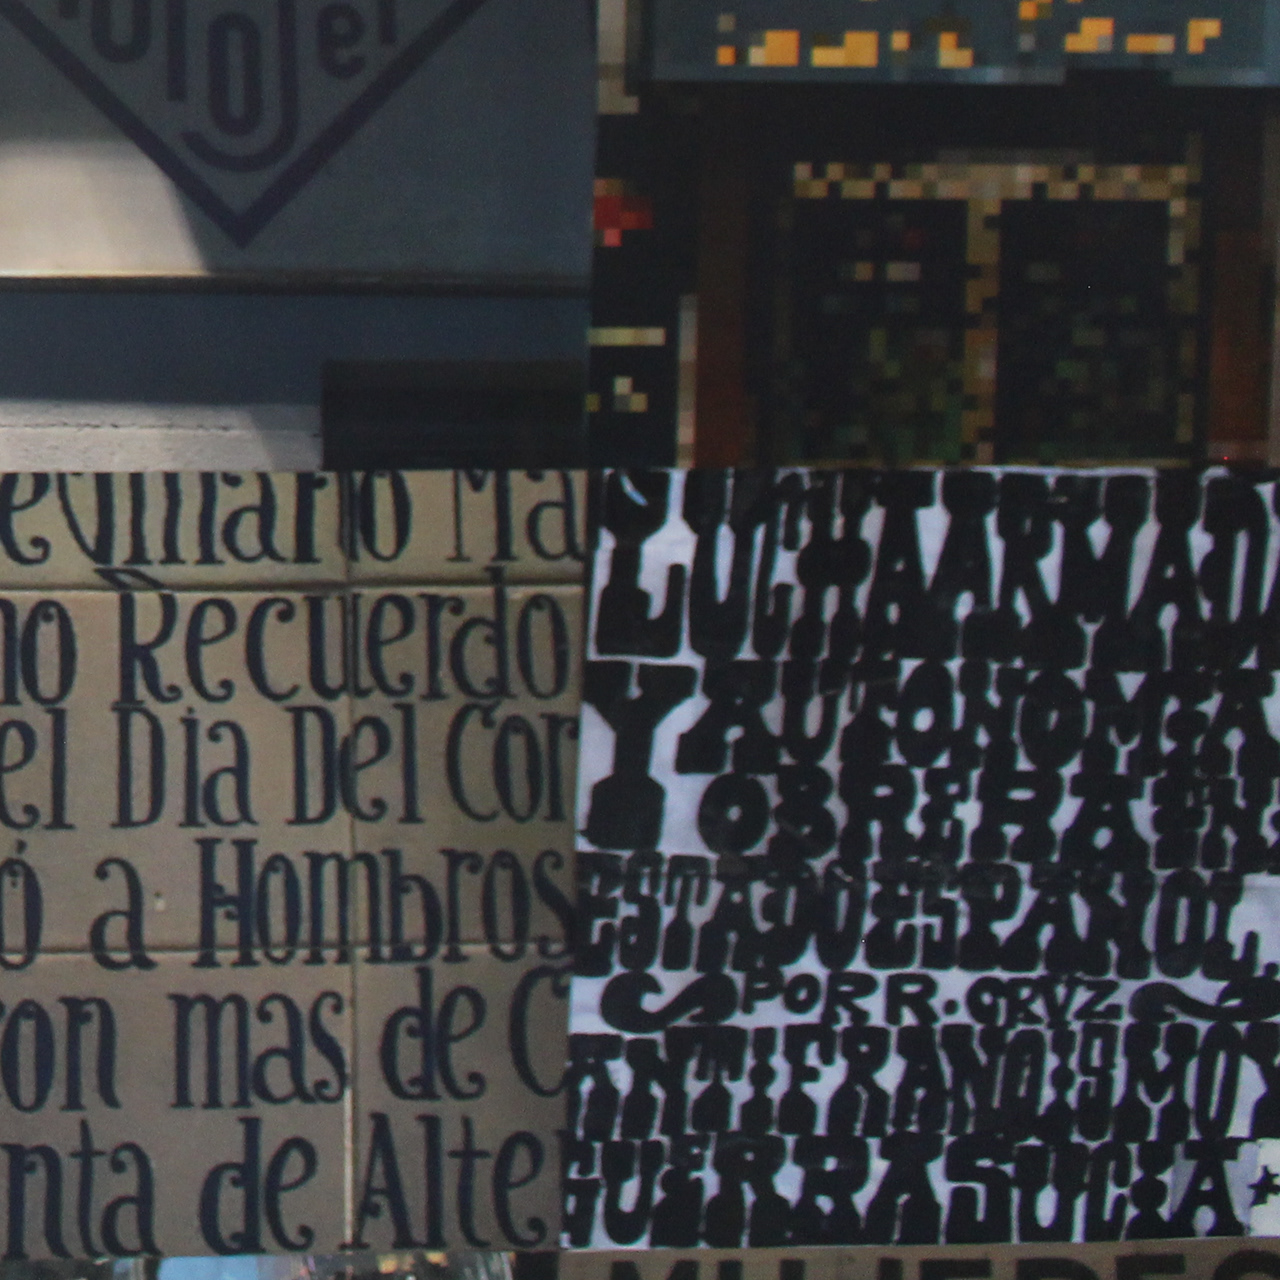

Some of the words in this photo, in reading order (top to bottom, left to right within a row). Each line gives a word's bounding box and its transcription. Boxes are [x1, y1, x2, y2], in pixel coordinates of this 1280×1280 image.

[93, 566, 569, 708] Recuerdo
[282, 702, 426, 825] Del
[89, 856, 158, 972] a
[192, 836, 576, 968] Hombros
[168, 989, 350, 1109] mas
[378, 965, 488, 1101] de
[197, 1114, 318, 1254] de
